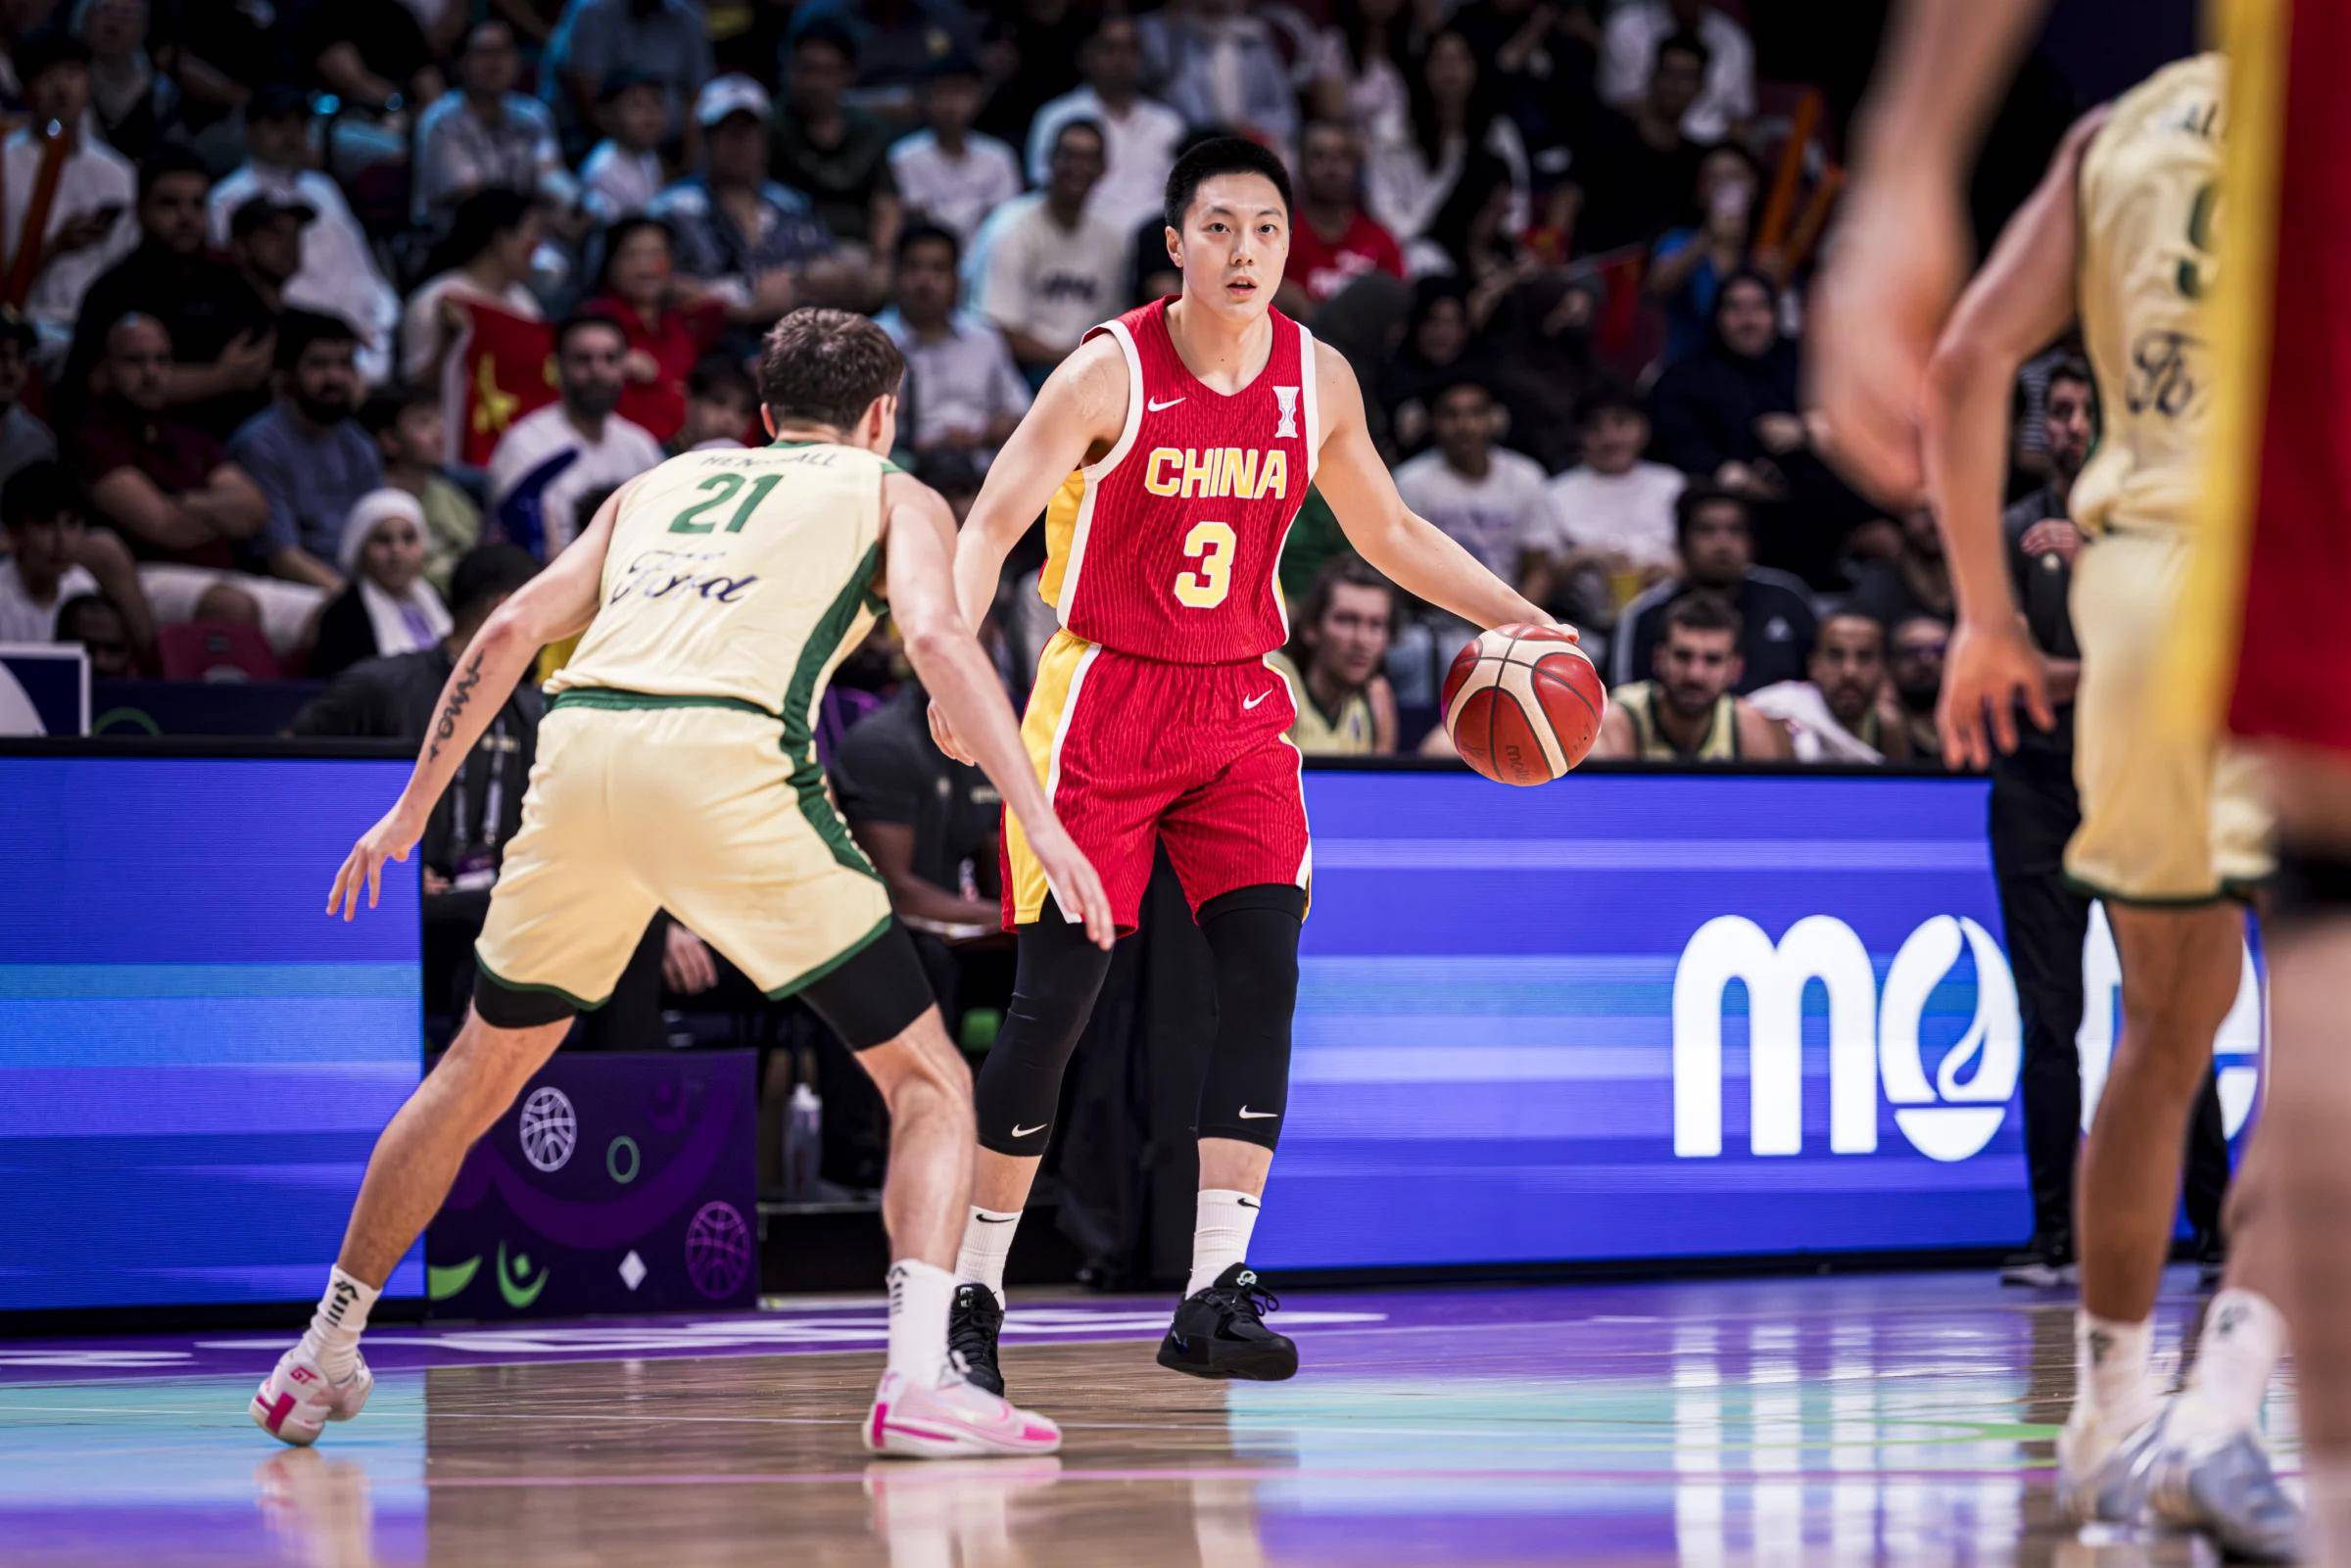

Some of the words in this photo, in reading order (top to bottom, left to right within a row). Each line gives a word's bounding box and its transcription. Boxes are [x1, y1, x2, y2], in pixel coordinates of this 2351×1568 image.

[699, 451, 839, 468] HENALL
[1144, 447, 1288, 499] CHINA
[668, 472, 785, 534] 21
[1174, 521, 1237, 609] 3
